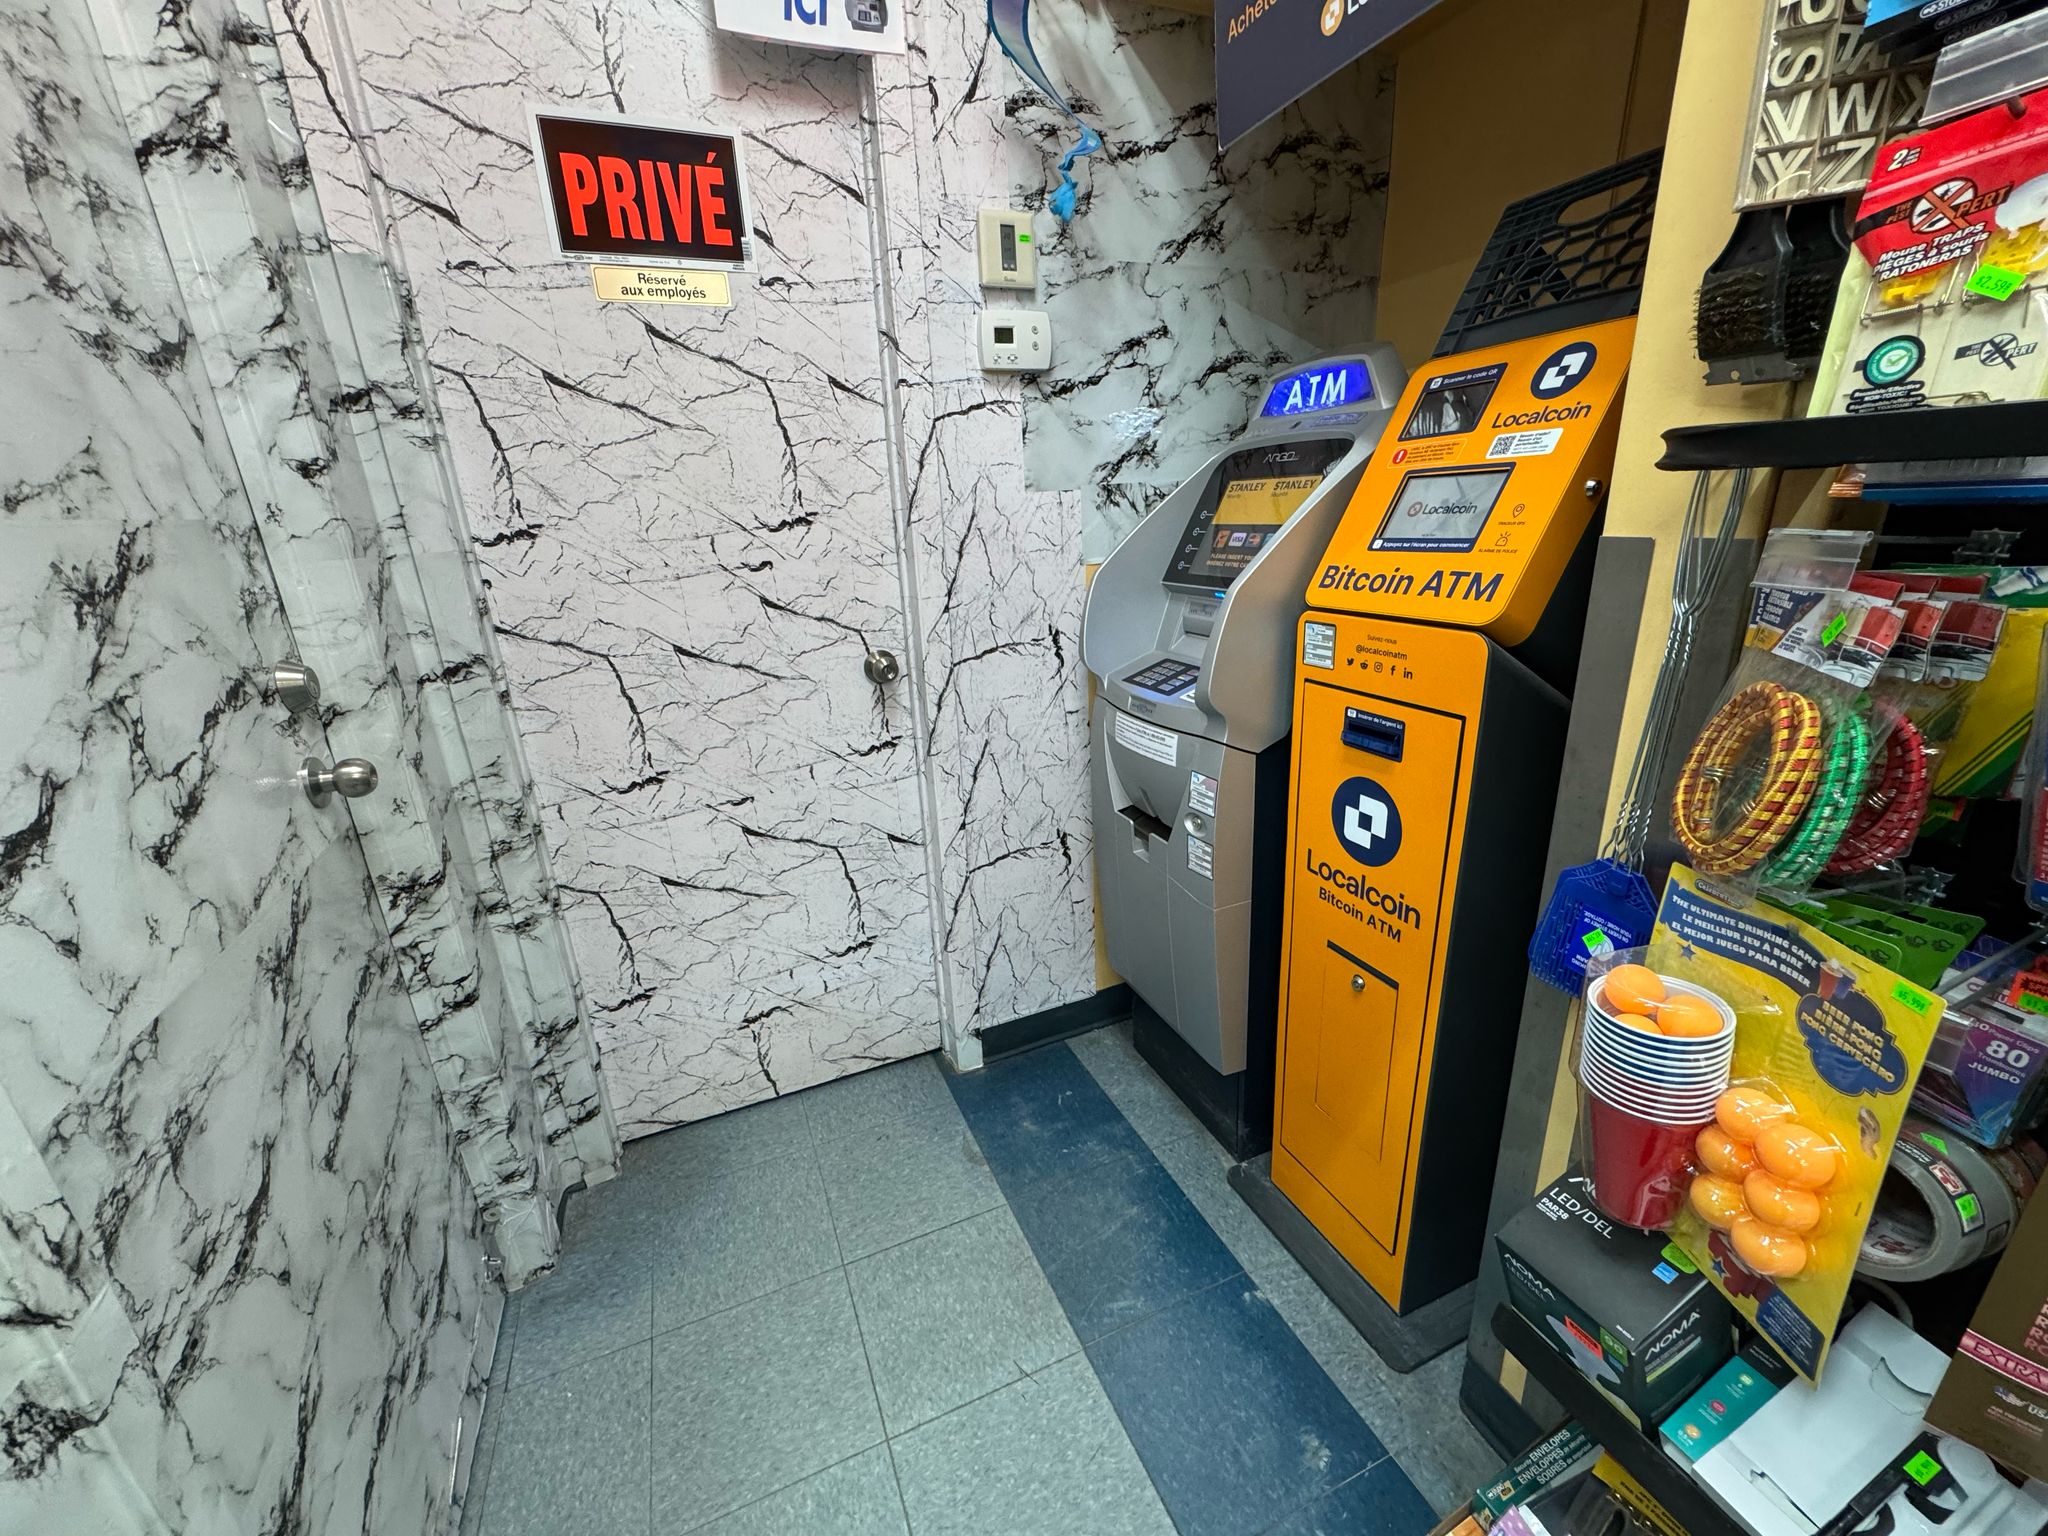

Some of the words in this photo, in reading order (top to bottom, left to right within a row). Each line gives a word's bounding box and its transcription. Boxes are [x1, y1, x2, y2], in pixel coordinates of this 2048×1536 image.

[559, 151, 733, 247] PRIVÉ
[1932, 222, 1986, 247] TRAPS
[637, 272, 686, 286] Réservé
[1879, 244, 1974, 280] RATONERAS
[621, 286, 643, 296] aux
[647, 285, 706, 300] employés
[1284, 369, 1347, 411] ATM
[1491, 401, 1592, 428] Localcoin
[1229, 482, 1267, 493] STANLEY
[1273, 479, 1317, 491] STANLEY
[1422, 502, 1478, 516] Localcoin
[1318, 564, 1415, 595] Bitcoin
[1417, 570, 1505, 602] ATM
[1356, 644, 1408, 660] @localcoinatm
[1306, 848, 1420, 930] Localcoin
[1318, 886, 1364, 922] Bitcoin
[1366, 913, 1402, 943] ATM
[1672, 894, 1689, 909] THE
[1690, 902, 1737, 927] ULTIMATE
[1737, 920, 1790, 949] DRINKING
[1790, 944, 1819, 969] GAME
[1671, 921, 1682, 931] EL
[1683, 926, 1714, 943] MEJOR
[1715, 935, 1747, 954] JUEGO
[1747, 950, 1778, 968] PARA
[1779, 963, 1812, 988] BEBER
[1682, 913, 1693, 923] LE
[1694, 917, 1741, 941] MEILLEUR
[1742, 934, 1761, 947] JEU
[1773, 946, 1805, 970] BOIRE
[1822, 1000, 1850, 1025] BEER
[1852, 1020, 1884, 1048] PONG
[1829, 1032, 1895, 1083] CERVECERO
[1968, 1061, 2020, 1084] JUMBO
[1985, 1040, 2030, 1068] 80
[1541, 1197, 1570, 1220] PAR38
[1549, 1187, 1614, 1239] LED/DEL
[1504, 1253, 1556, 1301] NOMA
[1645, 1311, 1701, 1360] NOMA
[1973, 1341, 2042, 1385] EXTRA
[1514, 1458, 1532, 1473] Security
[1529, 1429, 1571, 1462] ENVELOPES
[1517, 1447, 1565, 1485] ENVELOPPES
[1536, 1459, 1568, 1485] SOBRES
